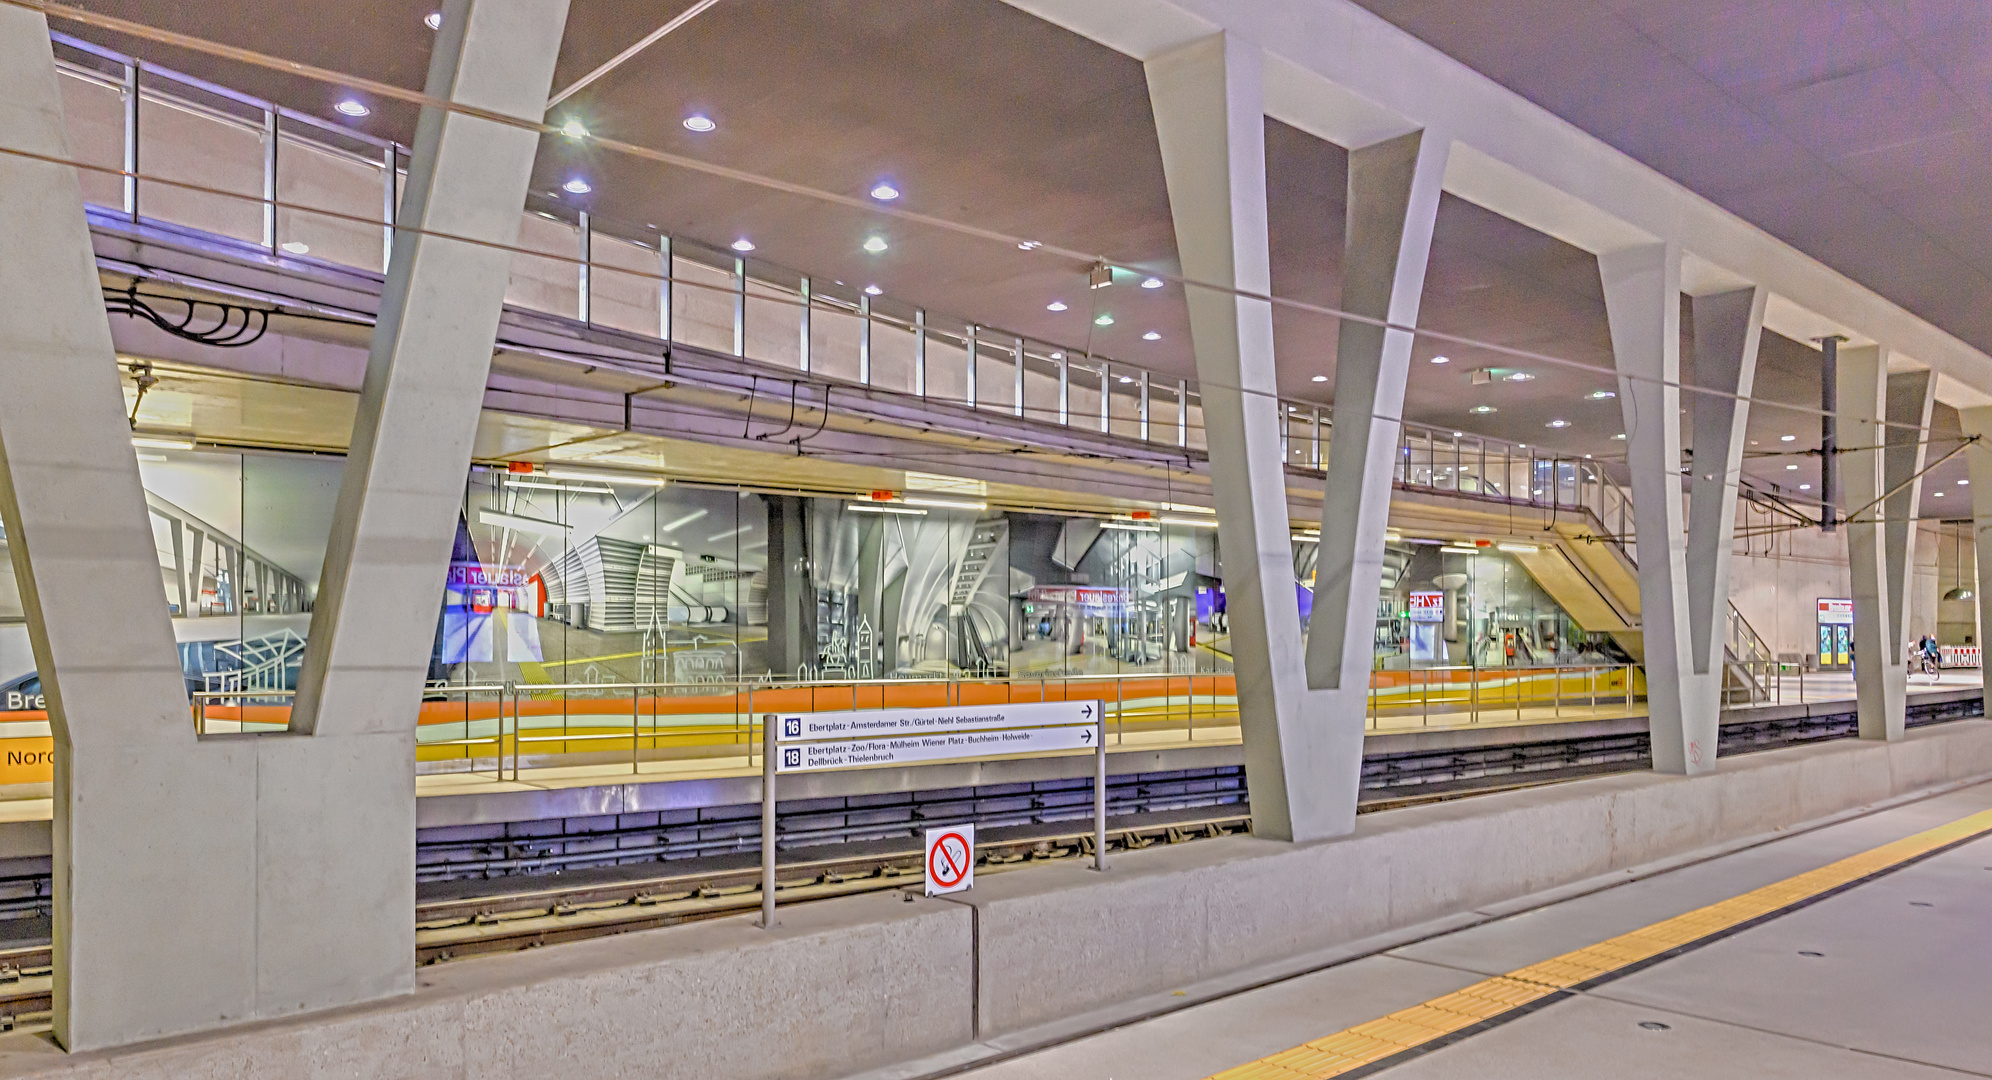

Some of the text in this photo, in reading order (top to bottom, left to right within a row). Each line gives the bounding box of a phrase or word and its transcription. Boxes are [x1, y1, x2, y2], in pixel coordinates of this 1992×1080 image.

[786, 719, 799, 735] 16
[809, 722, 846, 733] Ebertplatz
[850, 720, 897, 730] Amsterdamer
[938, 715, 954, 725] Niehl
[956, 714, 1005, 725] Sebastianstraße
[785, 732, 1030, 765] 18 Ebertplatz Zoo/Flora Mülheim Wiener Platz Buchheim Holweide
[808, 752, 894, 767] Dellbrück Thielenbruch
